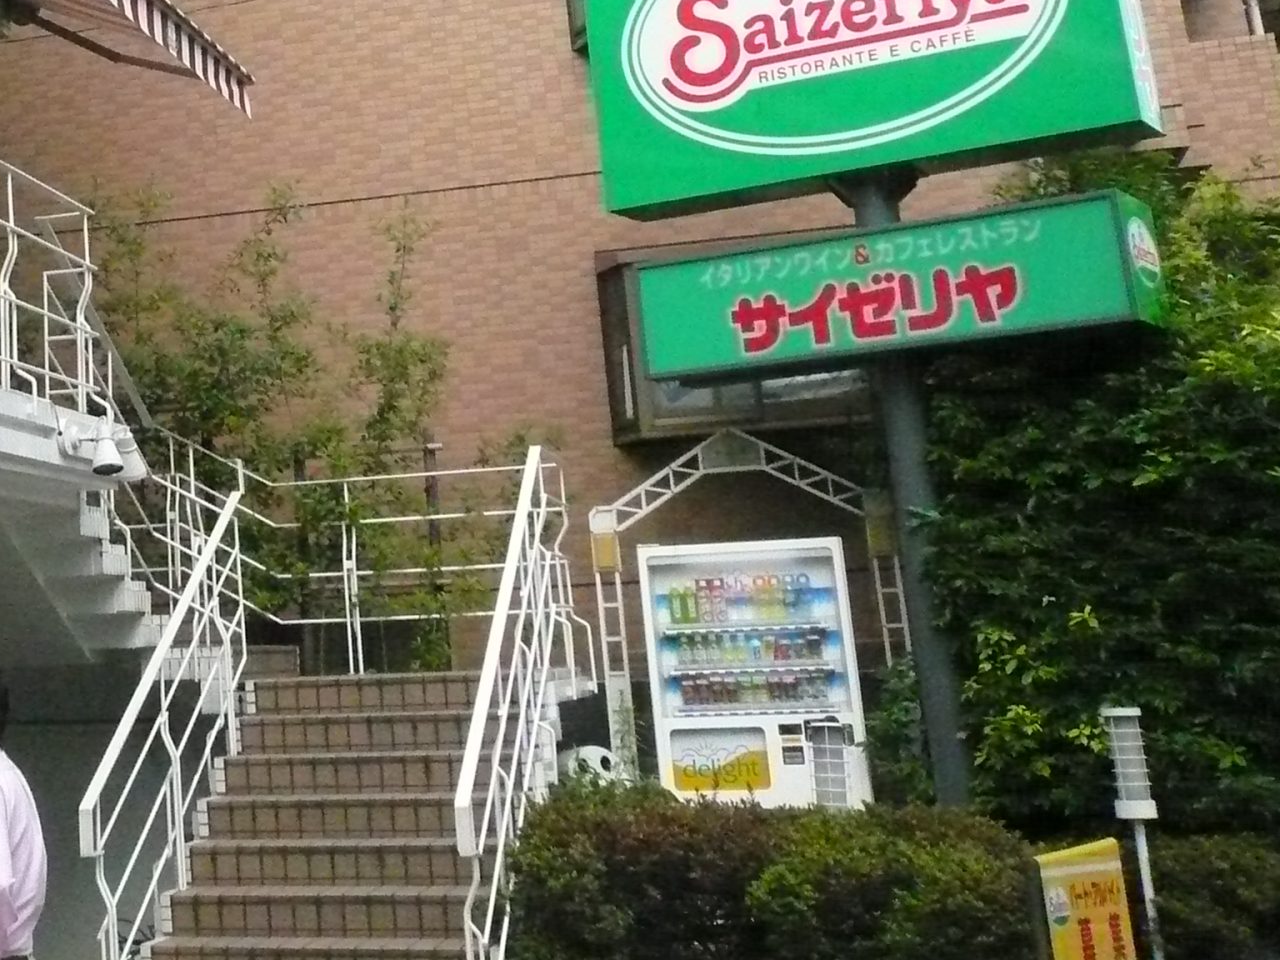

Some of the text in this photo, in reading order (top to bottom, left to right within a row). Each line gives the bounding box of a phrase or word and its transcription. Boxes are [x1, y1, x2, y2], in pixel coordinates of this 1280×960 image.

[758, 26, 977, 84] RISTORANTE E CAFFÈ
[730, 262, 1020, 355] サイゼリヤ
[683, 758, 761, 784] delight
